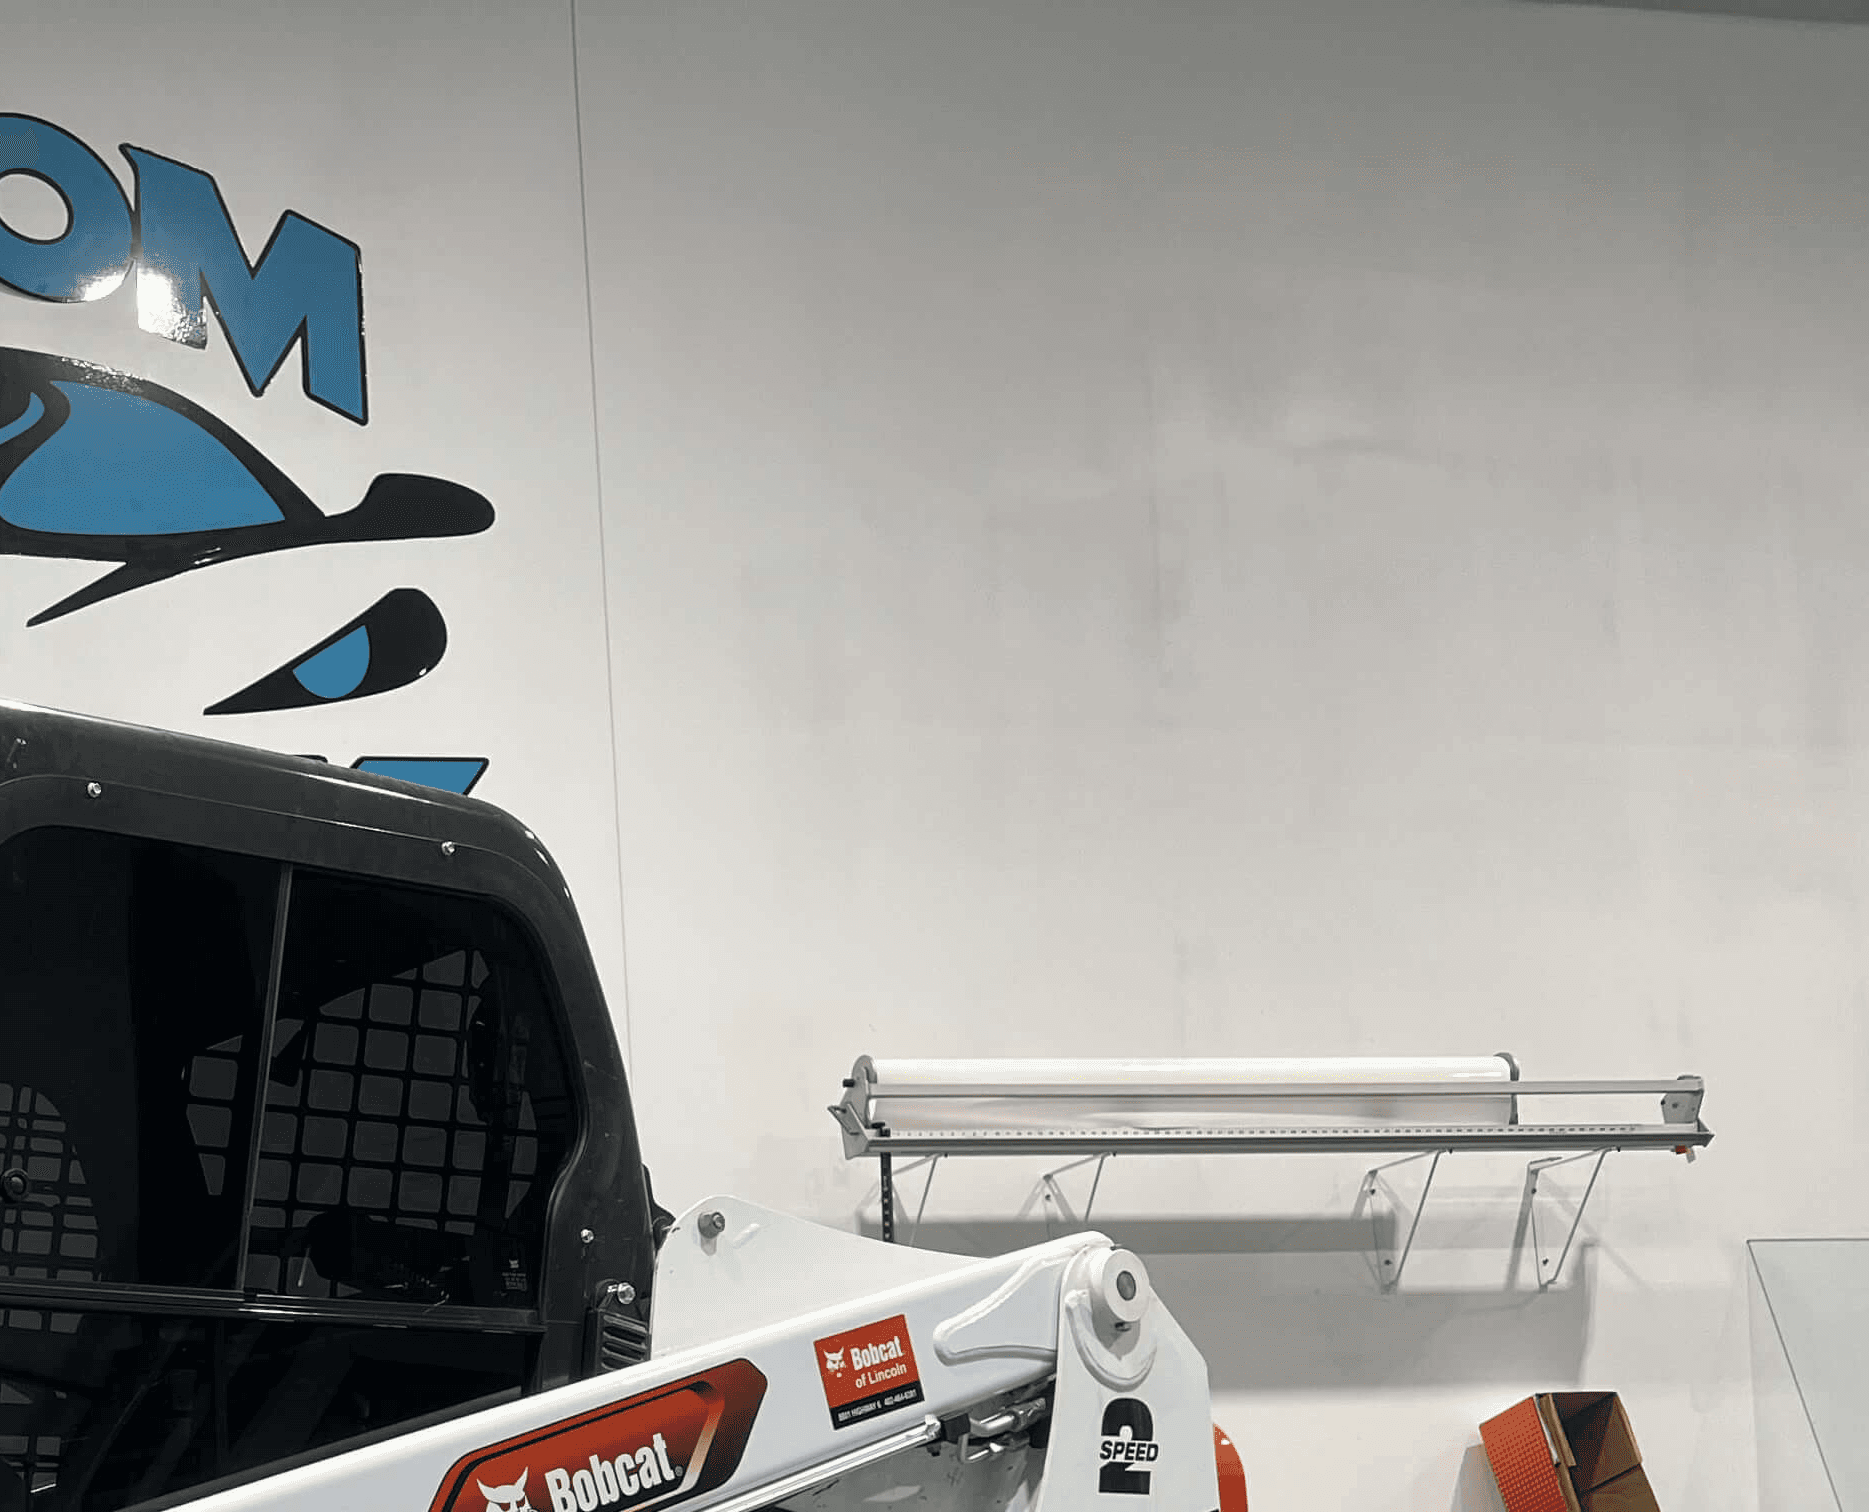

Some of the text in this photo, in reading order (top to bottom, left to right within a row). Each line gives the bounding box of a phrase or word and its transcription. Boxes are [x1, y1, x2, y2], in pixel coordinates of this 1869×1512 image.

[849, 1335, 906, 1371] Bobcat
[855, 1362, 907, 1389] of Lincoln
[1099, 1397, 1154, 1496] 2
[1099, 1440, 1160, 1462] SPEED
